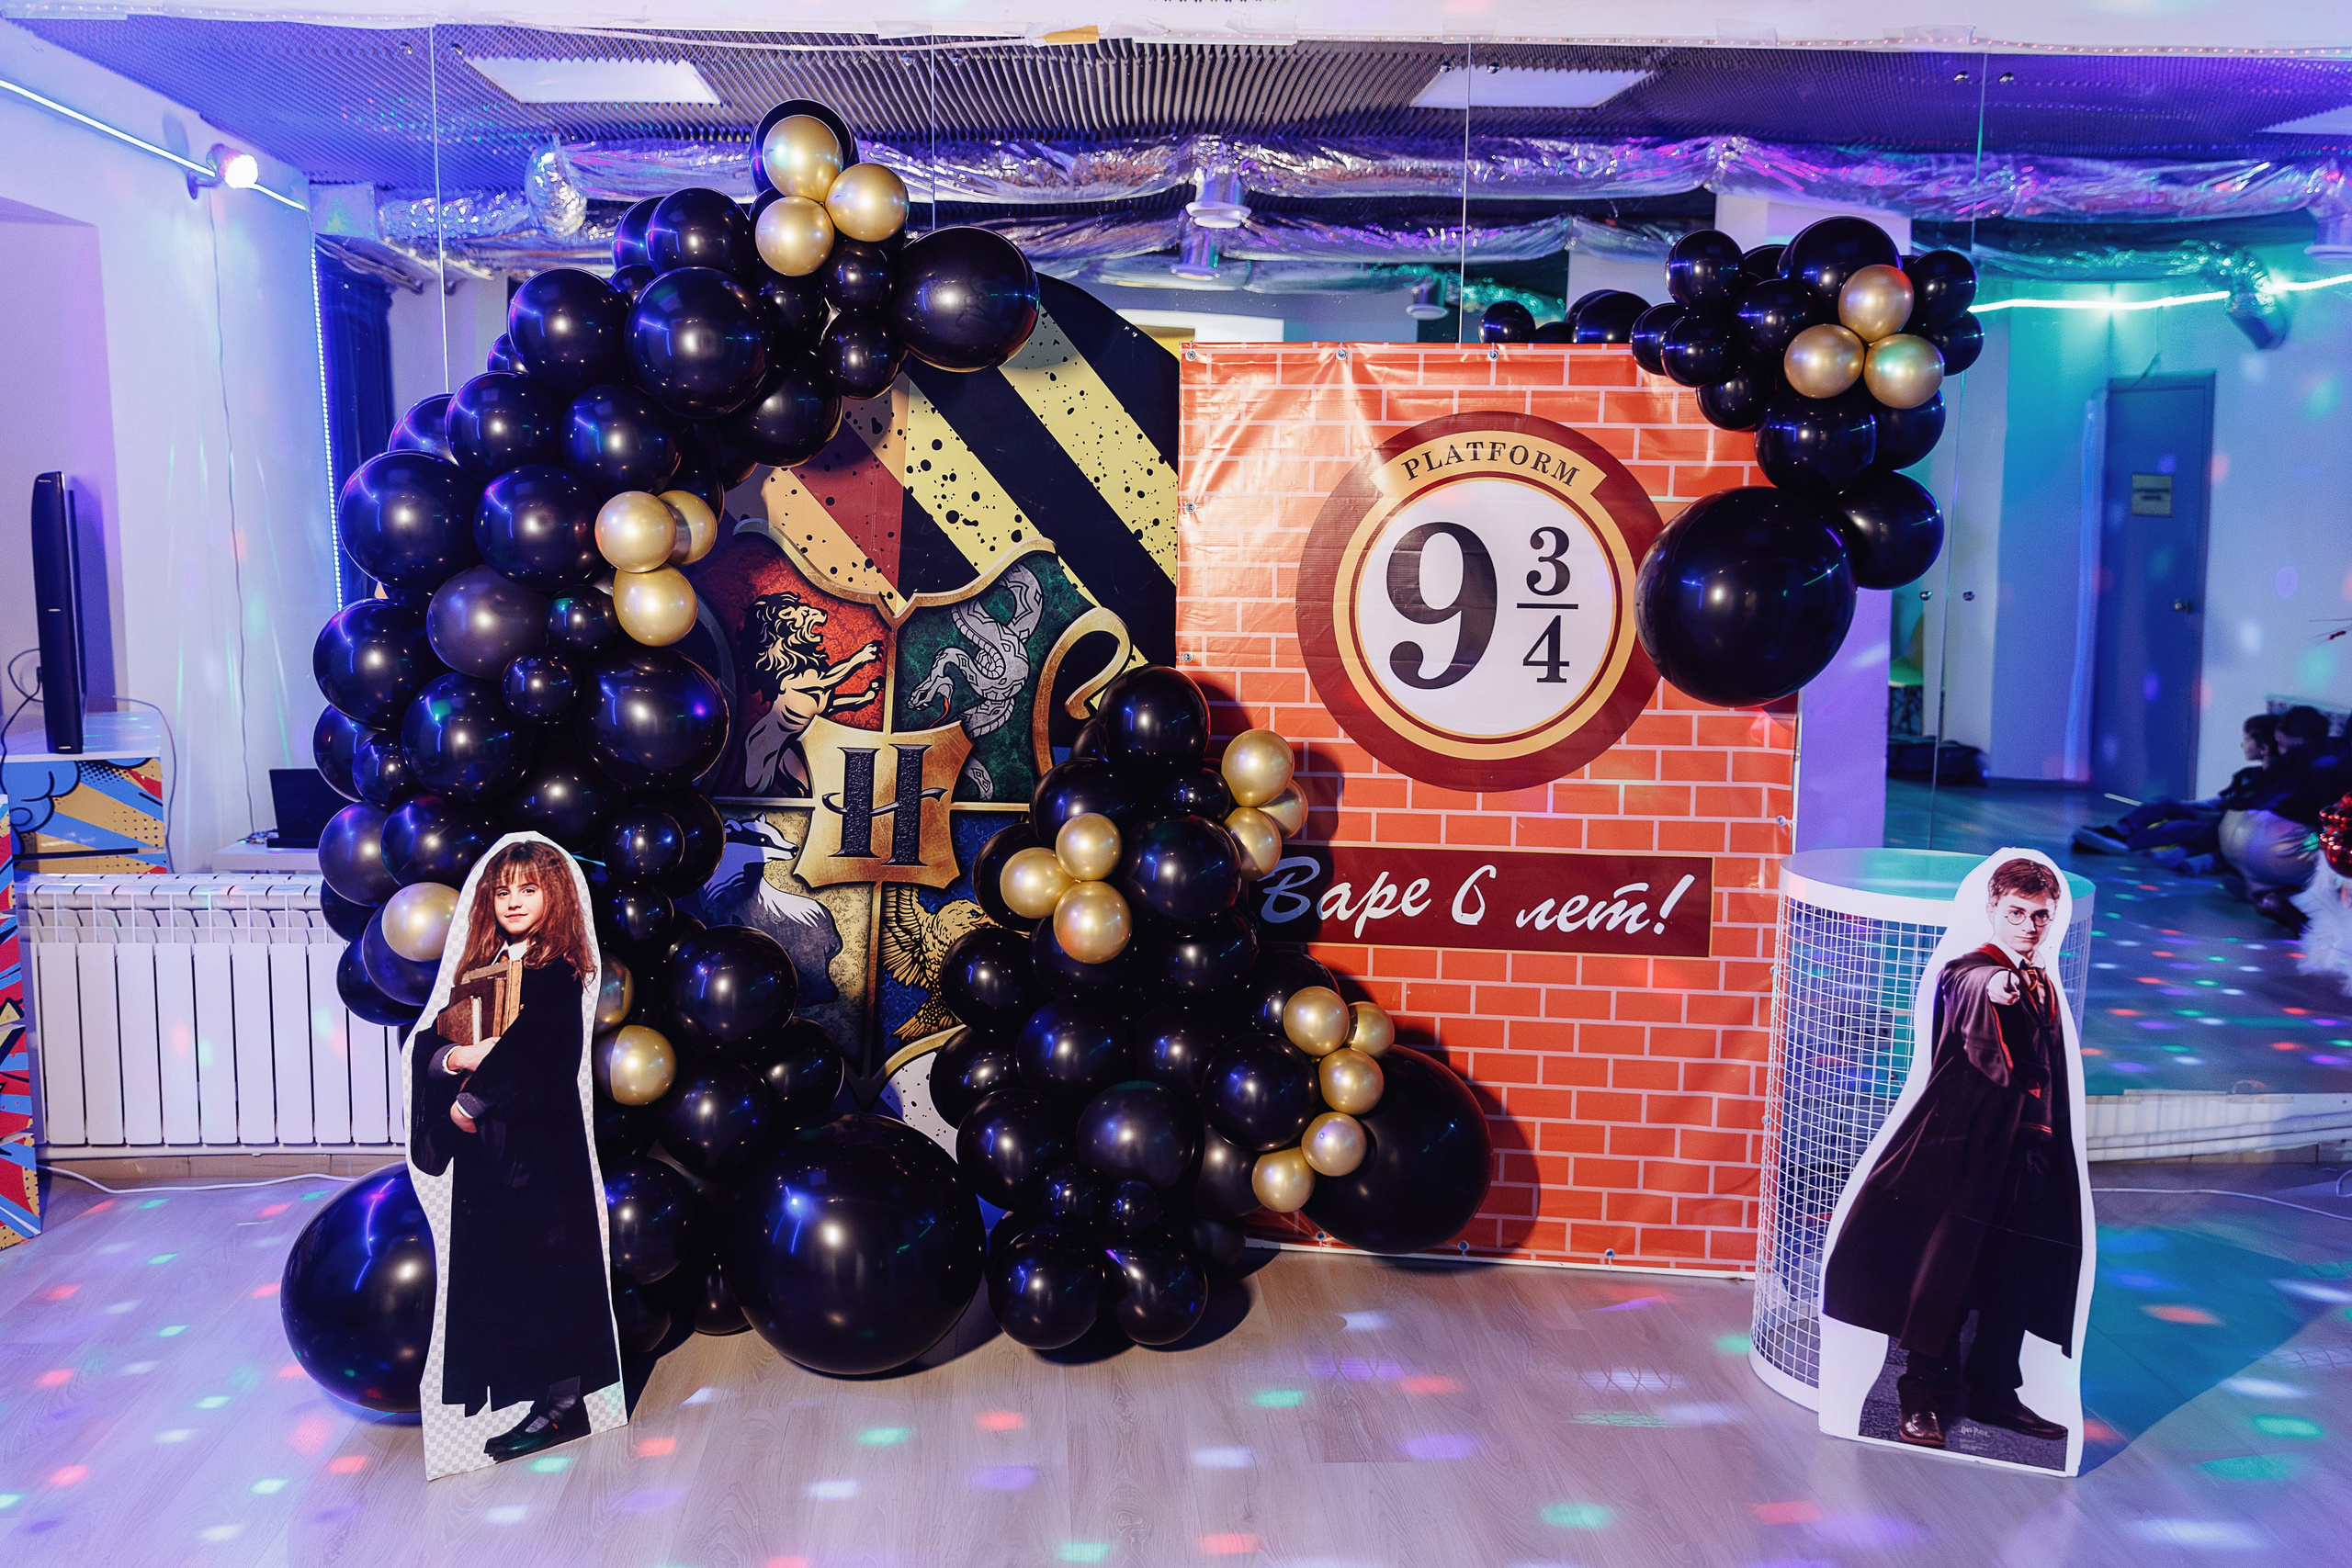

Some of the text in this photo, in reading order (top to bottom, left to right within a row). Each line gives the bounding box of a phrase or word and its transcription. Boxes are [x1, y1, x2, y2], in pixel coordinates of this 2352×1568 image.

[1401, 441, 1580, 487] PLATFORM
[1525, 526, 1571, 596] 3
[1385, 521, 1498, 690] 9
[1522, 615, 1570, 683] 4
[1257, 855, 1696, 939] Варе 6 лет!
